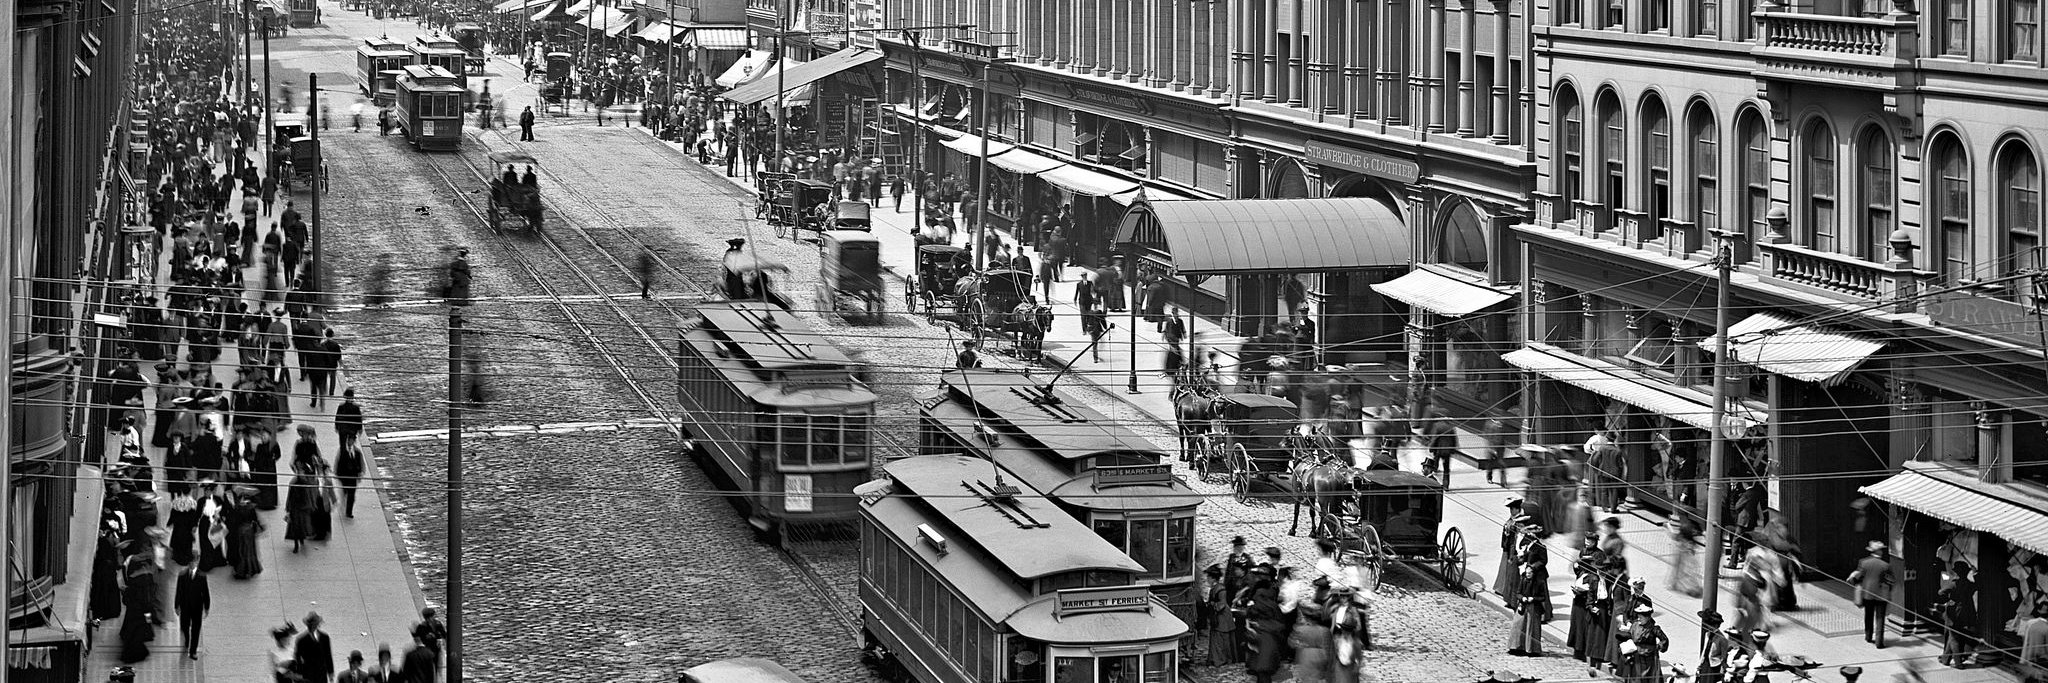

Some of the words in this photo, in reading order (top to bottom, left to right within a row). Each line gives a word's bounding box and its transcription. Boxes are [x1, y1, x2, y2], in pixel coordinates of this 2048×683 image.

[1307, 145, 1361, 168] STRAWBRIDGE
[1363, 157, 1369, 169] &
[1371, 158, 1416, 180] CLOTHIER.
[1125, 468, 1155, 476] MARKET
[1062, 600, 1094, 608] MARKET
[1111, 596, 1146, 606] FERRIES.
